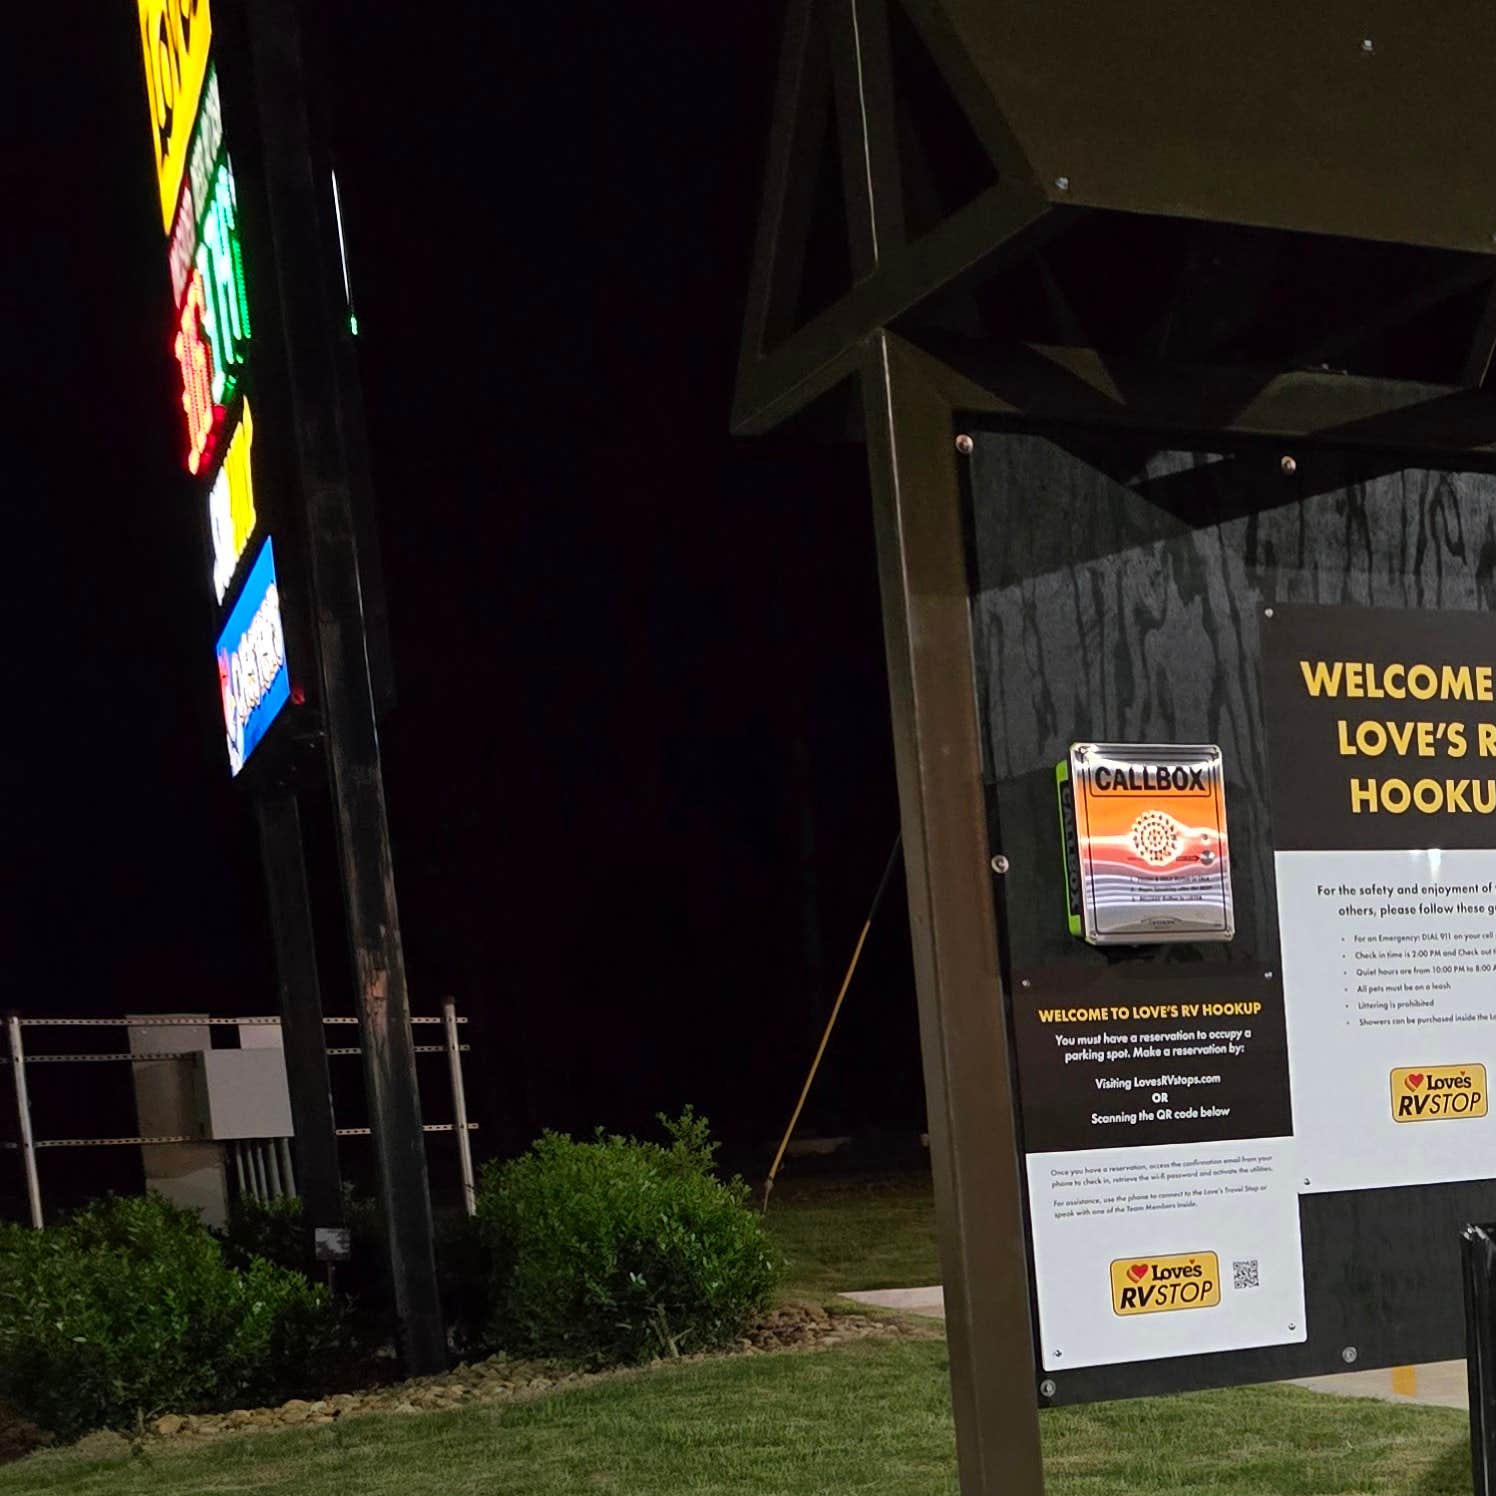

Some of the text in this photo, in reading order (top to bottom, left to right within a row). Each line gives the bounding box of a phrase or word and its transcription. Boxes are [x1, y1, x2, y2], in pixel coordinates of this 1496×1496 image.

[1300, 661, 1493, 700] WELCOME
[1338, 720, 1467, 757] LOVE'S
[1095, 766, 1205, 791] CALLBOX
[1318, 885, 1336, 895] For
[1339, 884, 1356, 895] the
[1360, 884, 1393, 897] safety
[1397, 883, 1418, 894] and
[1422, 883, 1478, 896] enjoyment
[1482, 882, 1492, 893] of
[1338, 904, 1376, 917] others,
[1380, 904, 1416, 918] please
[1419, 903, 1453, 914] follow
[1457, 902, 1484, 914] these
[1387, 950, 1402, 958] time
[1369, 986, 1384, 994] pets
[1432, 982, 1451, 990] leash
[1039, 1002, 1261, 1022] WELCOME TO LOVE'S RV HOOKUP
[1358, 1002, 1388, 1010] Littering
[1398, 1000, 1434, 1009] prohibited
[1418, 1015, 1453, 1024] purchased
[1455, 1013, 1475, 1021] inside
[1056, 1035, 1075, 1045] You
[1078, 1034, 1100, 1045] must
[1104, 1032, 1128, 1044] have
[1140, 1030, 1195, 1042] reservation
[1197, 1030, 1206, 1040] to
[1209, 1030, 1242, 1040] occupy
[1244, 1030, 1251, 1038] a
[1065, 1049, 1104, 1064] parking
[1107, 1049, 1130, 1062] spot.
[1133, 1046, 1161, 1058] Make
[1173, 1044, 1227, 1056] reservation
[1229, 1042, 1244, 1055] by:
[1096, 1075, 1221, 1090] Visiting LovesRVstops.com
[1152, 1093, 1168, 1103] OR
[1091, 1106, 1230, 1124] Scanning the QR code below
